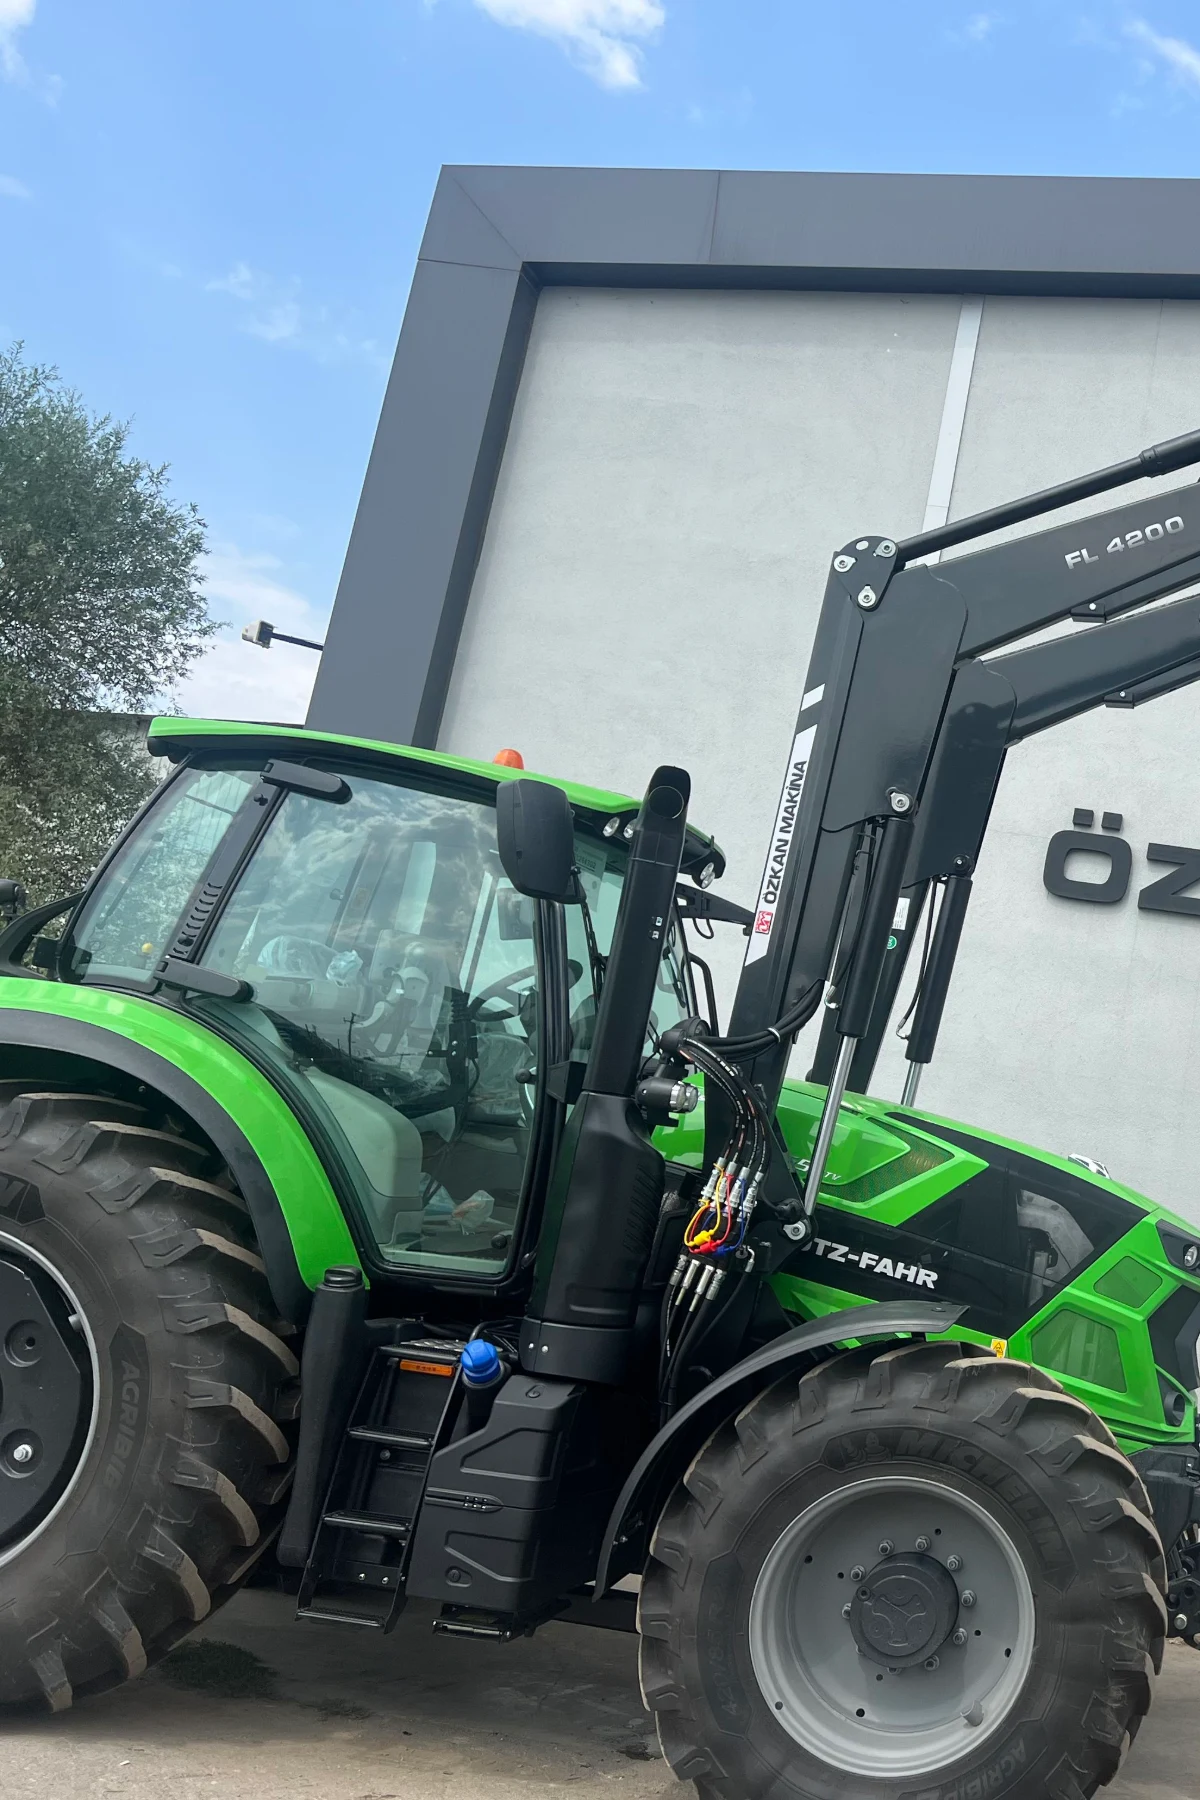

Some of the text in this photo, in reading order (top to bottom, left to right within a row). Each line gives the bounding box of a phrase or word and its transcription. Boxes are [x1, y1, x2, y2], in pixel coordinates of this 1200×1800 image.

[1064, 515, 1185, 570] FL 4200
[762, 760, 807, 905] ÖZKAN MAKİNA
[894, 1429, 1074, 1566] MICHELIN
